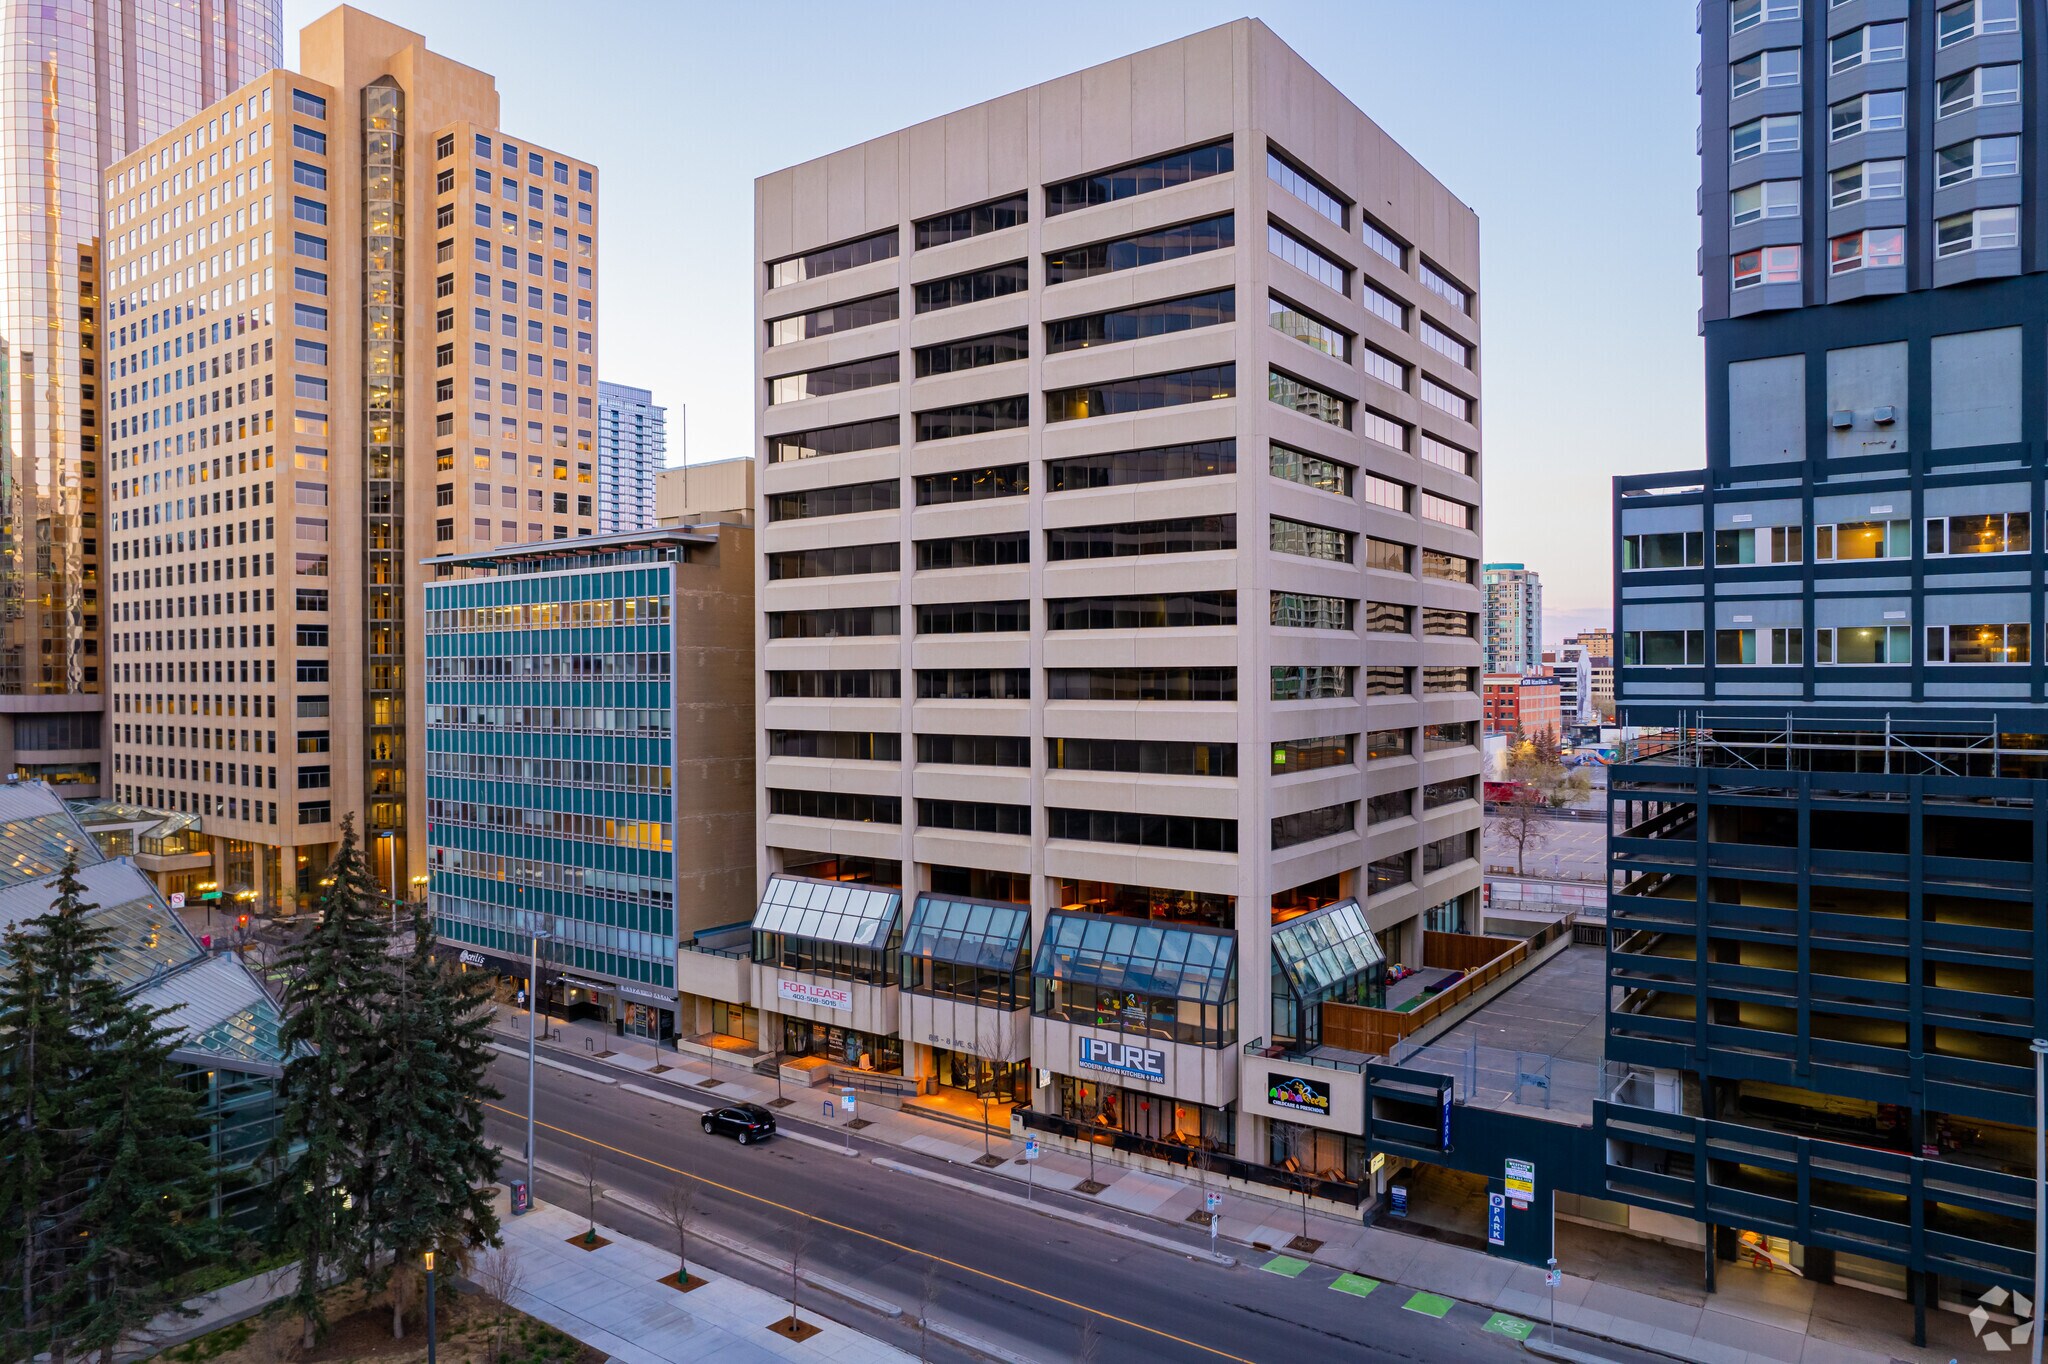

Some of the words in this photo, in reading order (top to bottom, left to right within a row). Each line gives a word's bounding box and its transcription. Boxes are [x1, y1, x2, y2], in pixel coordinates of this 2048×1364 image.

[783, 981, 806, 994] FOR
[810, 986, 847, 1002] LEASE
[793, 994, 836, 1006] 403-508-5015
[1080, 1061, 1103, 1071] MODERN
[1103, 1066, 1120, 1074] ASIAN
[1120, 1069, 1145, 1079] KITCHEN
[1151, 1075, 1163, 1083] BAR
[1493, 1207, 1501, 1239] PARK
